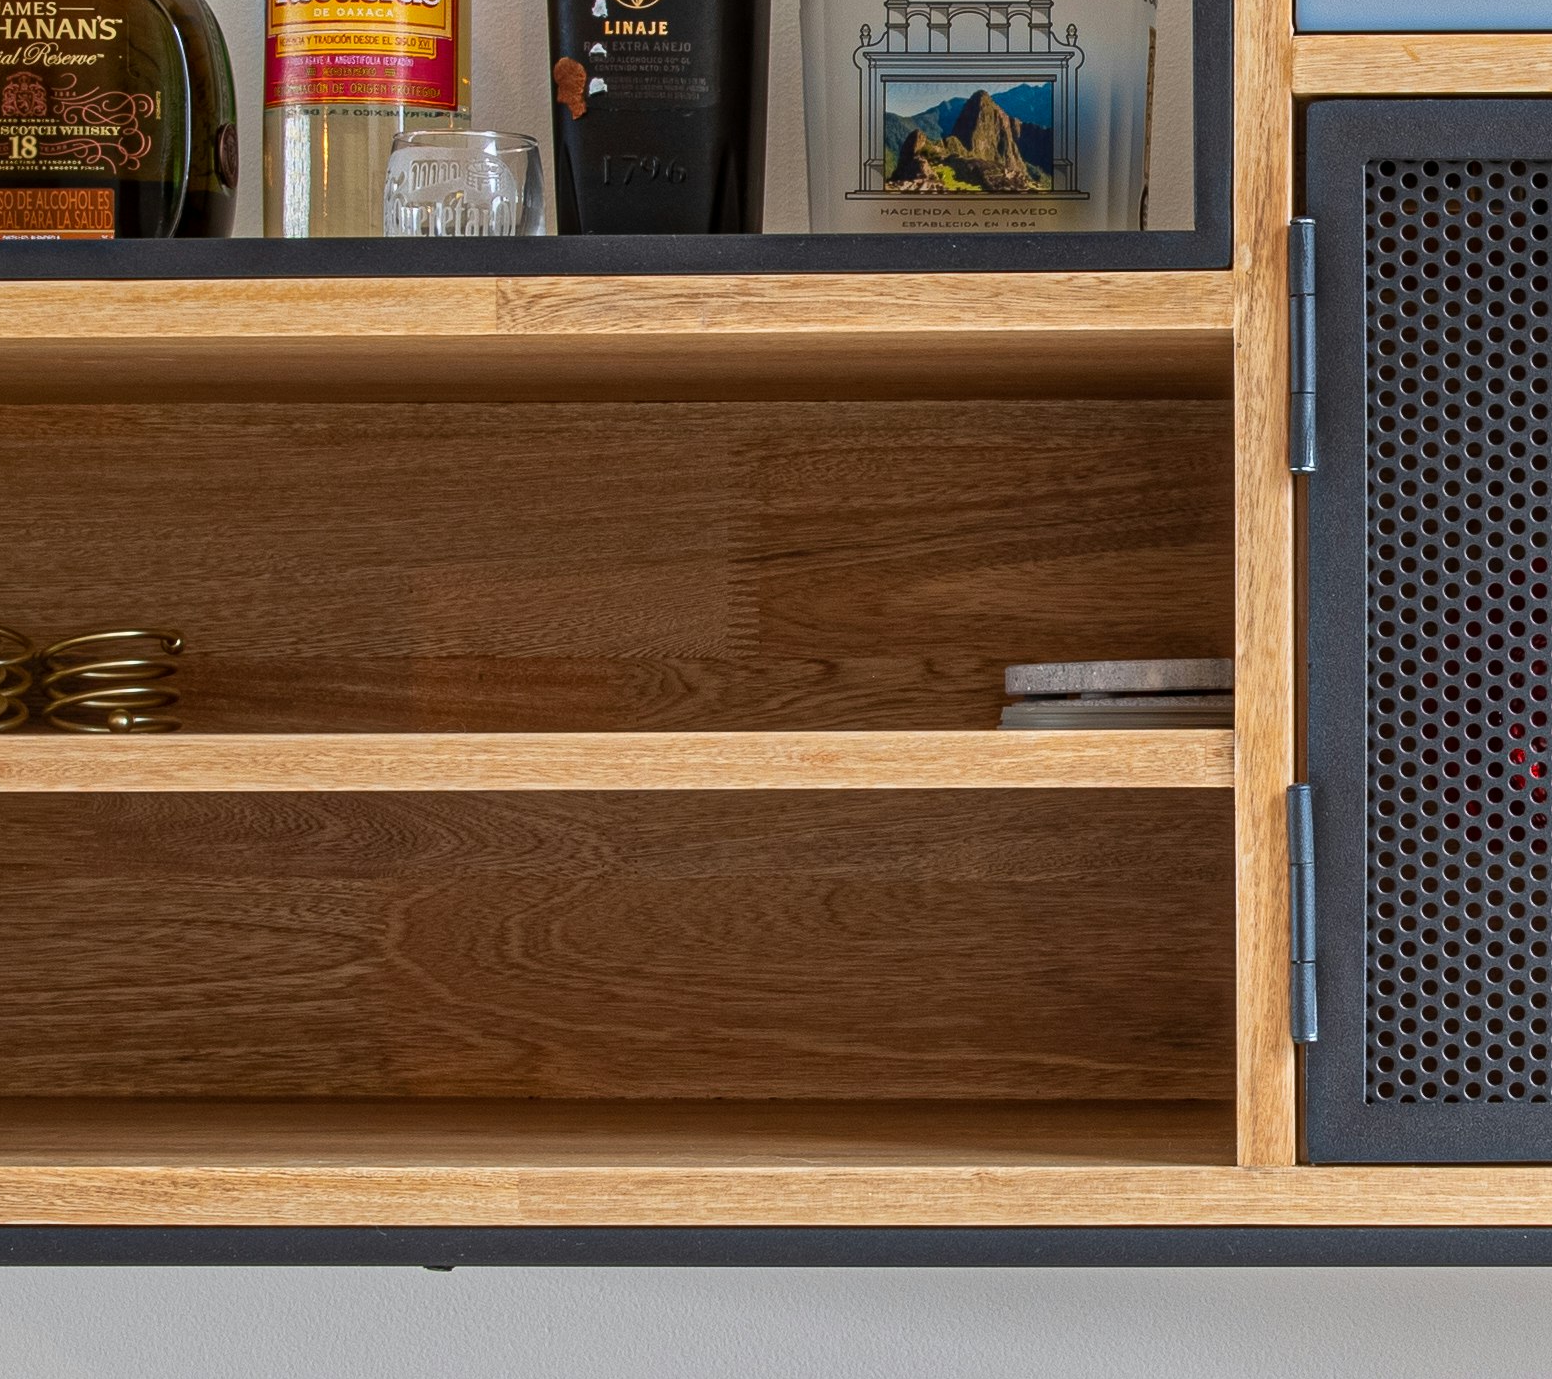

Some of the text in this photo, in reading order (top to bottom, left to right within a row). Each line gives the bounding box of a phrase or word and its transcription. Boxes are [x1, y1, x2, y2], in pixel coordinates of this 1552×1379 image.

[313, 7, 395, 18] DE OAXACA
[604, 21, 669, 36] LINAJE
[353, 35, 380, 45] DESDE
[382, 36, 392, 45] EL
[612, 41, 650, 52] EXTRA
[22, 41, 98, 67] Reserve
[332, 81, 344, 93] DE
[349, 82, 387, 94] ORIGEN
[0, 125, 57, 136] SCOTCH
[59, 126, 121, 137] WHISKY
[8, 135, 38, 160] 18
[603, 155, 687, 185] 1796
[17, 191, 33, 210] DE
[36, 191, 95, 210] ALCOHOL
[97, 191, 110, 210] ES
[880, 208, 1059, 216] HACIENDA LA CARAVEDO
[23, 211, 54, 230] PARA
[56, 211, 71, 230] LA
[74, 211, 114, 230] SALUD
